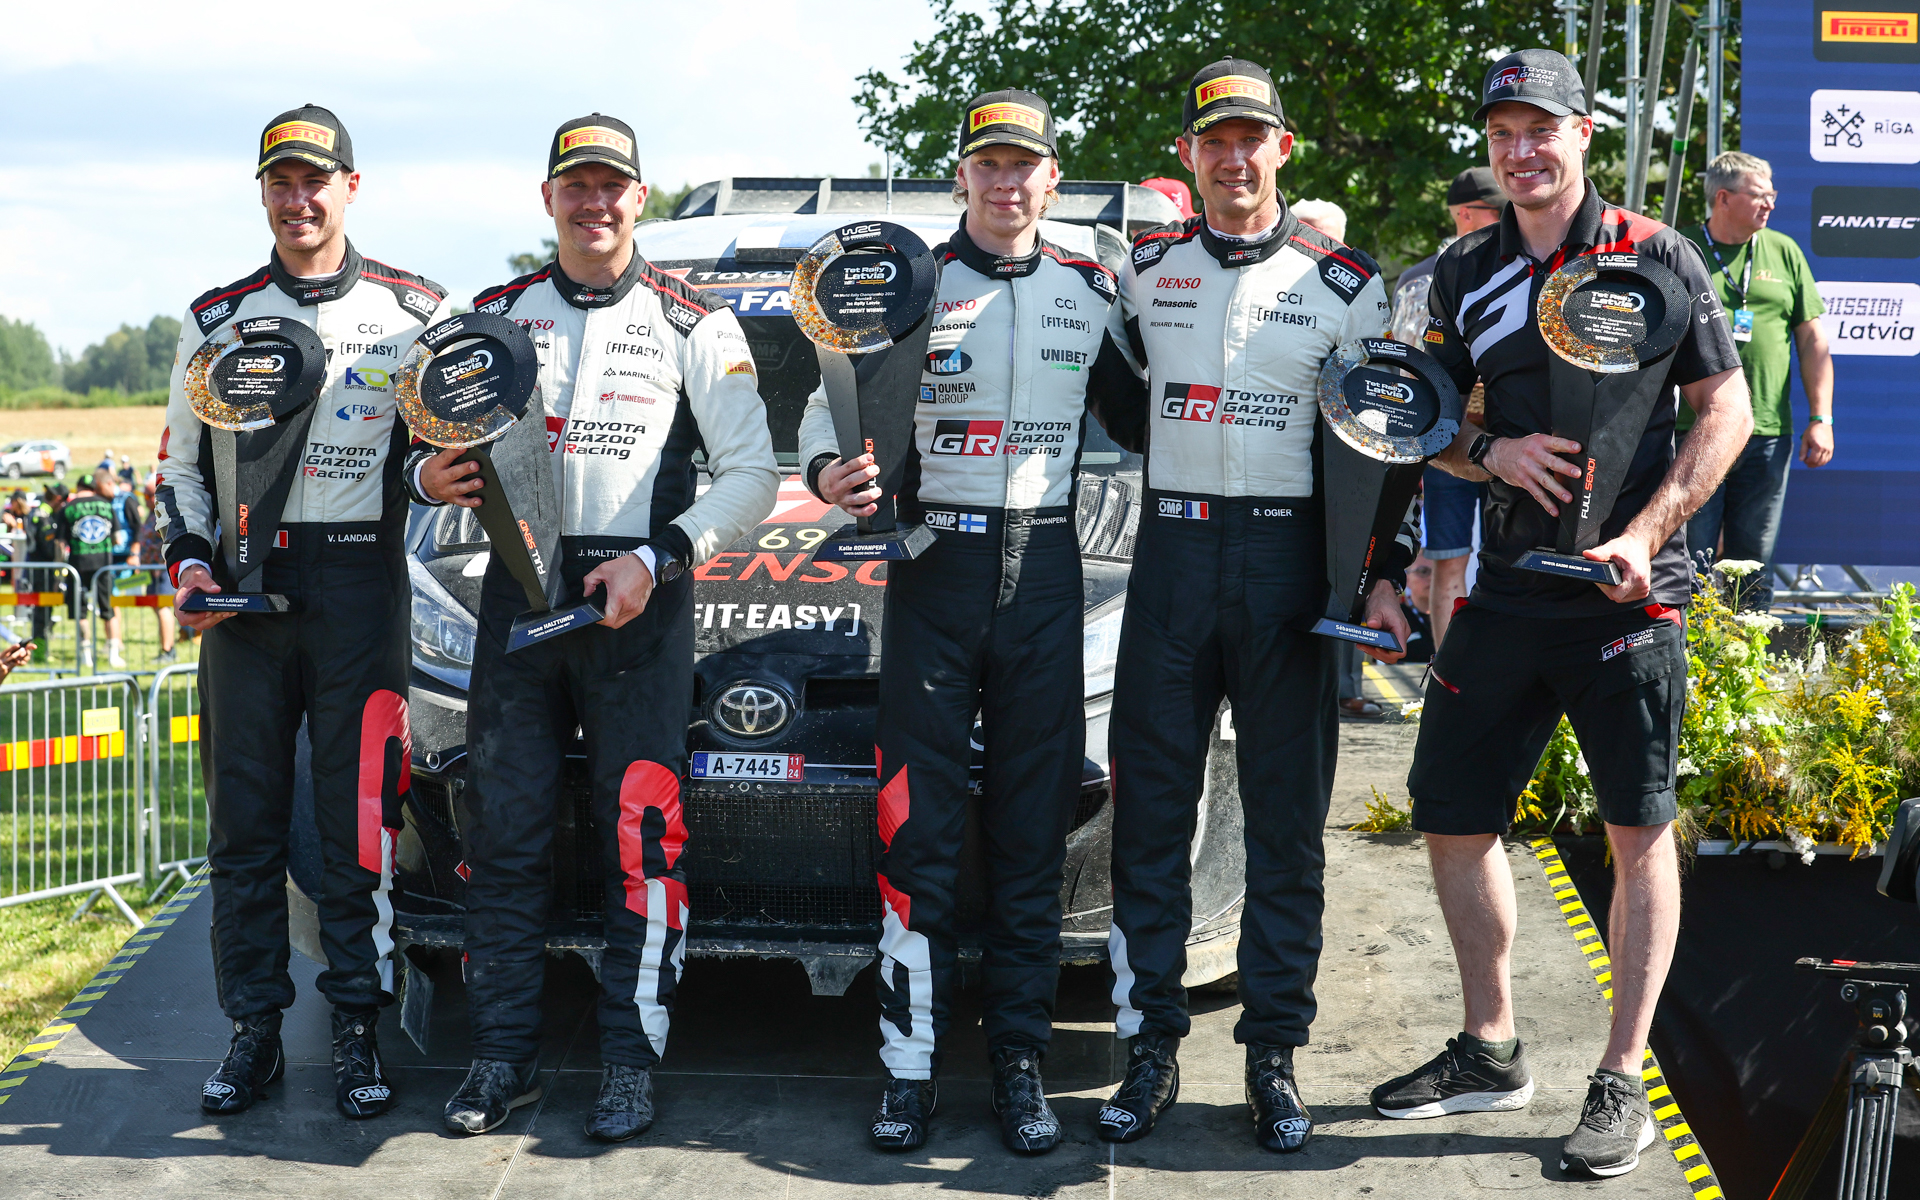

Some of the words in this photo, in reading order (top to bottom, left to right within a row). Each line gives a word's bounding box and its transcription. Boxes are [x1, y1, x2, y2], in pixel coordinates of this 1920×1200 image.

[1831, 18, 1909, 37] PIRELLI
[1520, 72, 1555, 81] GAZOO
[1521, 66, 1559, 77] TOYOTA
[1489, 71, 1516, 92] GR
[1518, 78, 1553, 87] Racing
[1200, 80, 1265, 102] PIRELLI
[974, 106, 1039, 129] PIRELLI
[1875, 119, 1914, 134] RĪGA
[267, 122, 328, 147] PIRELLI
[564, 129, 627, 151] PIRELLI
[842, 223, 882, 236] WRC
[1818, 215, 1916, 229] FANATEC
[1134, 244, 1160, 261] OMP
[1598, 254, 1639, 263] WRC
[697, 271, 794, 282] TOYO
[1156, 277, 1202, 289] DENSO
[1327, 265, 1360, 290] OMP
[404, 293, 435, 313] OMP
[1054, 298, 1077, 311] CCi
[1152, 298, 1198, 308] Panasonic
[1277, 291, 1303, 306] CCi
[201, 301, 231, 323] OMP
[934, 299, 977, 314] ENSO
[1821, 297, 1903, 317] MISSION
[242, 319, 281, 328] WRC
[668, 307, 697, 326] OMP
[358, 323, 383, 335] CCi
[425, 317, 463, 341] WRC
[515, 318, 555, 331] ENSO
[626, 324, 652, 338] CCi
[930, 320, 977, 333] nasonic
[1838, 320, 1914, 340] Latvia
[1369, 340, 1407, 353] WRC
[1041, 348, 1088, 365] UNIBET
[441, 365, 458, 374] Tet
[458, 356, 480, 368] Rally
[444, 362, 484, 380] Latvia
[938, 383, 976, 394] OUNEVA
[1365, 379, 1381, 388] Tet
[1381, 383, 1404, 393] Rally
[1366, 385, 1404, 399] Latvia
[616, 393, 657, 406] KONNEGROUP
[938, 393, 969, 404] GROUP
[1227, 389, 1299, 405] TOYOTA
[1161, 390, 1217, 422] GR
[1223, 402, 1291, 416] GAZOO
[572, 419, 646, 435] TOYOTA
[1013, 420, 1072, 432] TOYOTA
[1220, 414, 1287, 431] Racing
[565, 432, 637, 446] GAZOO
[931, 427, 1000, 456] GR
[1007, 433, 1065, 444] GAZOO
[310, 442, 378, 457] TOYOTA
[563, 443, 631, 460] Racing
[1003, 445, 1062, 458] Racing
[305, 454, 371, 469] GAZOO
[303, 466, 366, 482] Racing
[1158, 500, 1183, 515] OMP
[1253, 508, 1262, 518] S.
[1264, 508, 1293, 518] OGIER
[1580, 492, 1592, 519] FULL
[239, 503, 249, 537] SEND!
[925, 511, 957, 527] OMP
[1022, 518, 1030, 527] K.
[327, 534, 336, 543] V.
[338, 533, 378, 543] LANDAIS
[757, 527, 828, 551] 69
[240, 537, 249, 564] FULL
[577, 548, 585, 557] J.
[587, 548, 634, 558] HALTTUN
[531, 548, 546, 576] FULL
[1357, 569, 1369, 596] FULL
[543, 613, 575, 630] HALTTUNEN
[1362, 630, 1379, 638] OGIER
[1625, 628, 1656, 640] TOYOTA
[1626, 632, 1653, 644] GAZOO
[712, 757, 781, 776] A-7445
[789, 757, 799, 766] 11
[788, 769, 799, 778] 24
[202, 1084, 232, 1096] OMP
[354, 1087, 391, 1100] OMP
[1099, 1107, 1131, 1123] OMP
[872, 1124, 907, 1135] OMP
